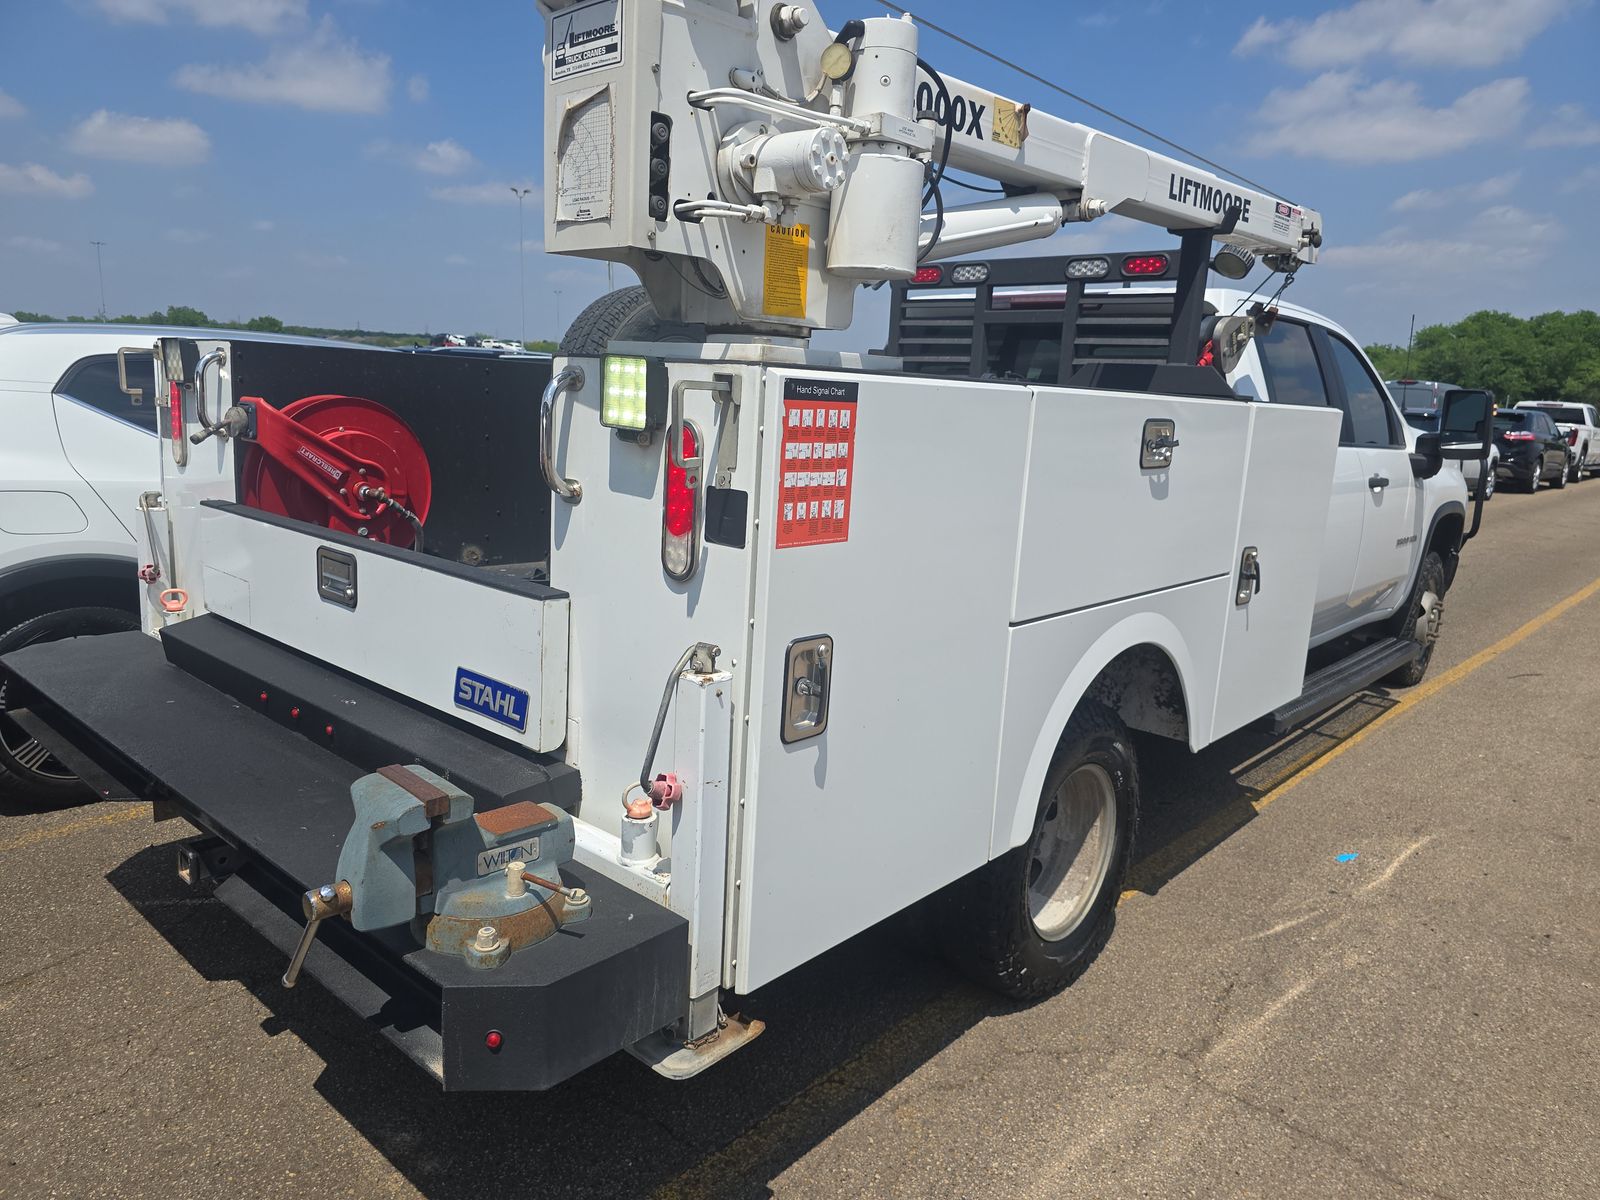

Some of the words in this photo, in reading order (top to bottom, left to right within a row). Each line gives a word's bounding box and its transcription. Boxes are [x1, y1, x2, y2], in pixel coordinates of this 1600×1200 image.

[569, 24, 618, 48] LIFTMOORE
[565, 52, 582, 64] TRUCK
[583, 47, 606, 60] CRANES
[1169, 173, 1251, 223] LIFTMOORE
[770, 225, 805, 238] CAUTION
[796, 385, 812, 395] Hand
[813, 386, 830, 396] Signal
[830, 387, 845, 396] Chart
[301, 448, 336, 476] REELCRAFT
[458, 676, 520, 722] STAHL
[483, 842, 532, 869] WILTON
